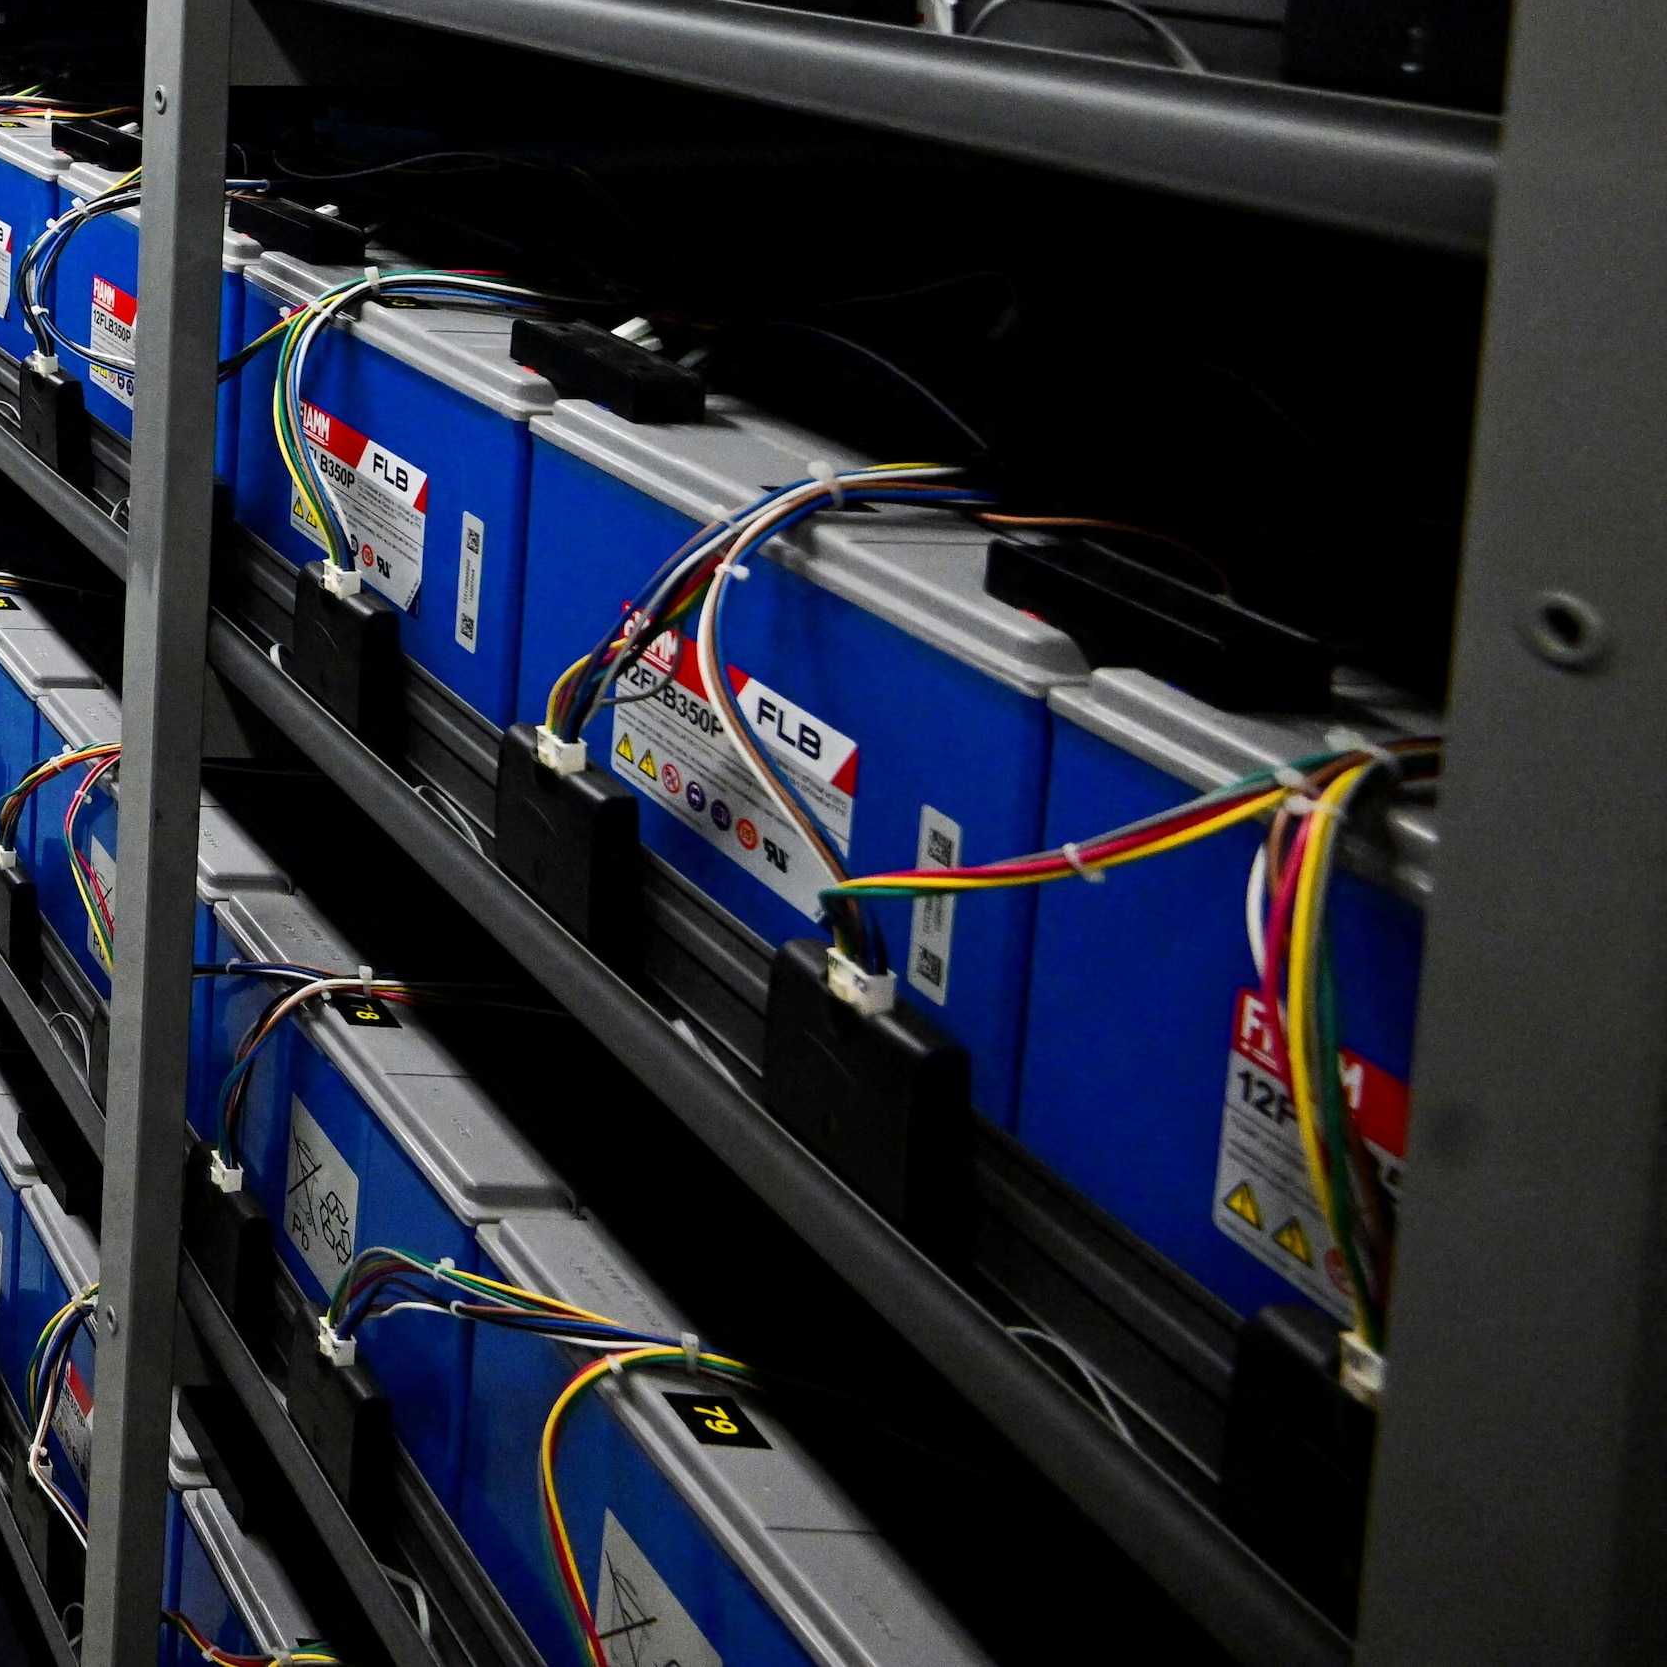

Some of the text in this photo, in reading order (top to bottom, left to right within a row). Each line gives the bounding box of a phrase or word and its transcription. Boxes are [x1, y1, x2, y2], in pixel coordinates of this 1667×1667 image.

[93, 276, 116, 309] FIAMM
[93, 309, 132, 344] 12FLB350P
[372, 451, 409, 493] FLB
[756, 696, 822, 761] FLB
[293, 1212, 311, 1251] Pb
[693, 1405, 741, 1436] 79
